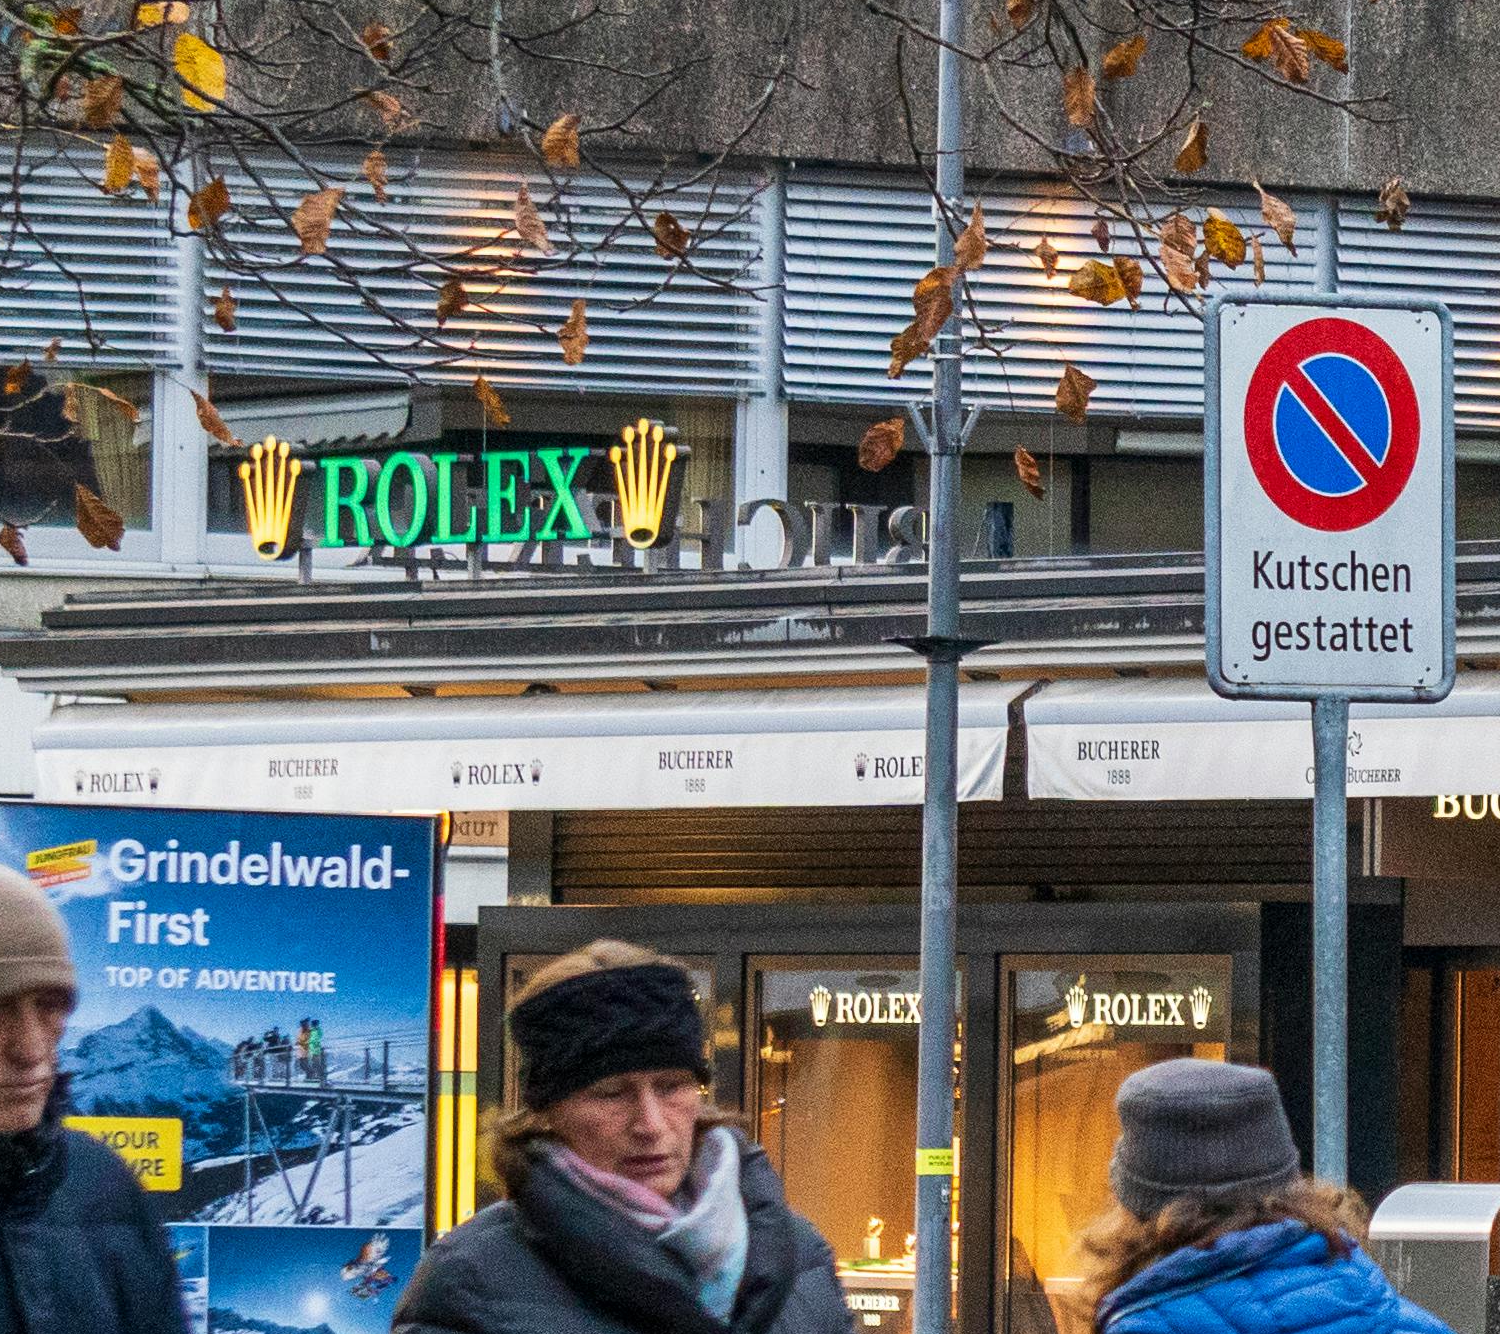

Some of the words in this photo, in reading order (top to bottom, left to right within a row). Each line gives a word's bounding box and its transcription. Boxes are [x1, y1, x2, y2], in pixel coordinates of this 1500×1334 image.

[320, 446, 591, 549] ROLEX
[1252, 550, 1413, 594] Kutschen
[1251, 616, 1414, 662] gestattet
[658, 750, 734, 770] BUCHERER
[1076, 739, 1161, 761] BUCHERER
[268, 757, 339, 778] BUCHERER
[467, 763, 526, 786] ROLEX
[874, 755, 927, 779] ROLE
[1106, 769, 1132, 785] 1888
[1346, 767, 1402, 784] BUCHERER
[90, 772, 145, 794] ROLEX
[684, 778, 706, 793] 1888
[107, 837, 411, 891] Grindelwald-
[107, 900, 211, 947] First
[106, 965, 155, 989] TOP
[158, 967, 190, 990] OF
[196, 968, 337, 993] ADVENTURE
[835, 992, 922, 1025] ROLEX
[1092, 993, 1186, 1027] ROLEX
[100, 1130, 159, 1149] YOUR
